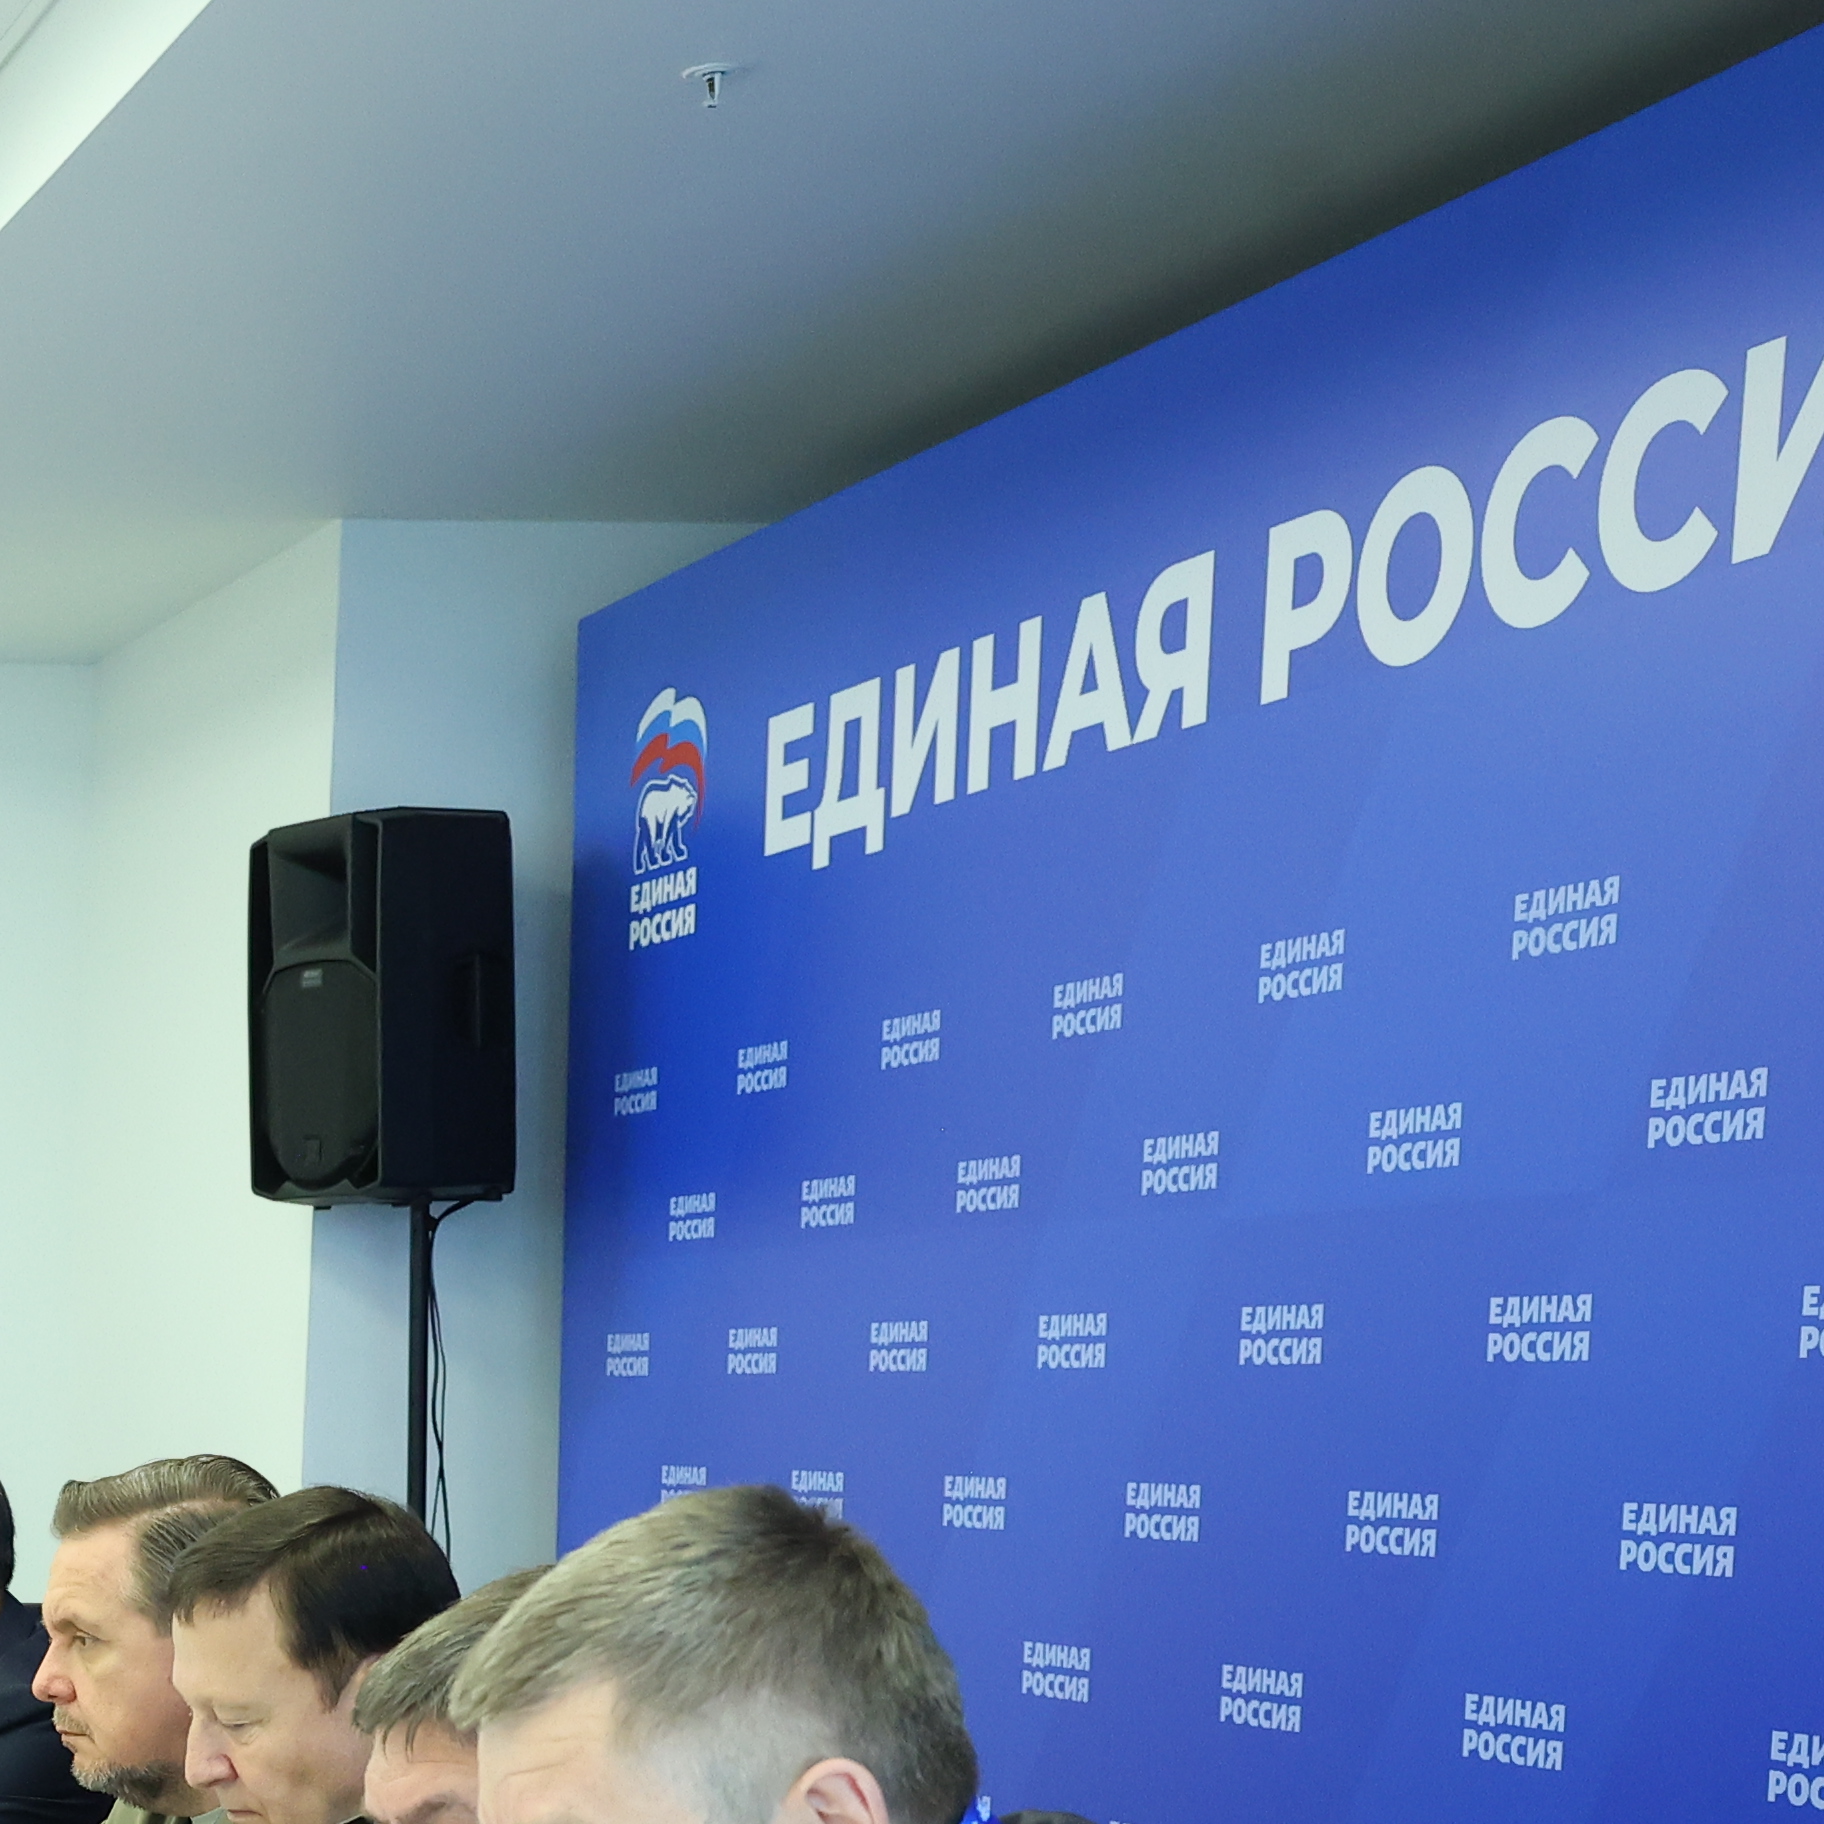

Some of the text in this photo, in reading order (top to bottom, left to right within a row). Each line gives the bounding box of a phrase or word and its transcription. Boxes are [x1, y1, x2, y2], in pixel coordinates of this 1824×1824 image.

[764, 549, 1215, 870] ЕДИНАЯ
[630, 867, 696, 914] ЕДИНАЯ
[1514, 876, 1619, 923] ЕДИНАЯ
[629, 903, 695, 950] РОССИЯ
[1512, 914, 1617, 960] РОССИЯ
[1260, 929, 1345, 970] ЕДИНАЯ
[1054, 973, 1123, 1009] ЕДИНАЯ
[1258, 963, 1343, 1003] РОССИЯ
[882, 1010, 940, 1042] ЕДИНАЯ
[1052, 1004, 1122, 1039] РОССИЯ
[738, 1040, 788, 1070] ЕДИНАЯ
[881, 1038, 940, 1070] РОССИЯ
[615, 1067, 657, 1092] ЕДИНАЯ
[737, 1066, 786, 1095] РОССИЯ
[1650, 1067, 1768, 1110] ЕДИНАЯ
[614, 1090, 657, 1115] РОССИЯ
[1369, 1102, 1462, 1140] ЕДИНАЯ
[1648, 1107, 1765, 1148] РОССИЯ
[1143, 1131, 1219, 1164] ЕДИНАЯ
[1367, 1138, 1460, 1174] РОССИЯ
[958, 1155, 1020, 1185] ЕДИНАЯ
[1142, 1163, 1217, 1195] РОССИЯ
[802, 1175, 855, 1203] ЕДИНАЯ
[956, 1184, 1019, 1213] РОССИЯ
[670, 1192, 715, 1217] ЕДИНАЯ
[801, 1202, 854, 1228] РОССИЯ
[669, 1217, 714, 1241] РОССИЯ
[1241, 1304, 1324, 1334] ЕДИНАЯ
[1489, 1294, 1592, 1328] ЕДИНАЯ
[729, 1327, 777, 1350] ЕДИНАЯ
[871, 1321, 928, 1346] ЕДИНАЯ
[1039, 1313, 1107, 1340] ЕДИНАЯ
[607, 1333, 649, 1353] ЕДИНАЯ
[1037, 1343, 1106, 1369] РОССИЯ
[1239, 1337, 1322, 1365] РОССИЯ
[1487, 1331, 1590, 1362] РОССИЯ
[607, 1357, 648, 1376] РОССИЯ
[728, 1353, 776, 1374] РОССИЯ
[869, 1348, 927, 1372] РОССИЯ
[662, 1465, 707, 1486] ЕДИНАЯ
[791, 1470, 844, 1493] ЕДИНАЯ
[944, 1476, 1006, 1501] ЕДИНАЯ
[1126, 1482, 1200, 1510] ЕДИНАЯ
[1348, 1491, 1438, 1521] ЕДИНАЯ
[943, 1504, 1005, 1530] РОССИЯ
[1125, 1513, 1199, 1542] РОССИЯ
[1622, 1502, 1737, 1536] ЕДИНАЯ
[1345, 1525, 1436, 1557] РОССИЯ
[1620, 1540, 1734, 1577] РОССИЯ
[1024, 1641, 1090, 1671] ЕДИНАЯ
[1022, 1670, 1089, 1703] РОССИЯ
[1221, 1664, 1303, 1698] ЕДИНАЯ
[1220, 1696, 1301, 1732] РОССИЯ
[1465, 1693, 1566, 1732] ЕДИНАЯ
[1462, 1729, 1563, 1770] РОССИЯ
